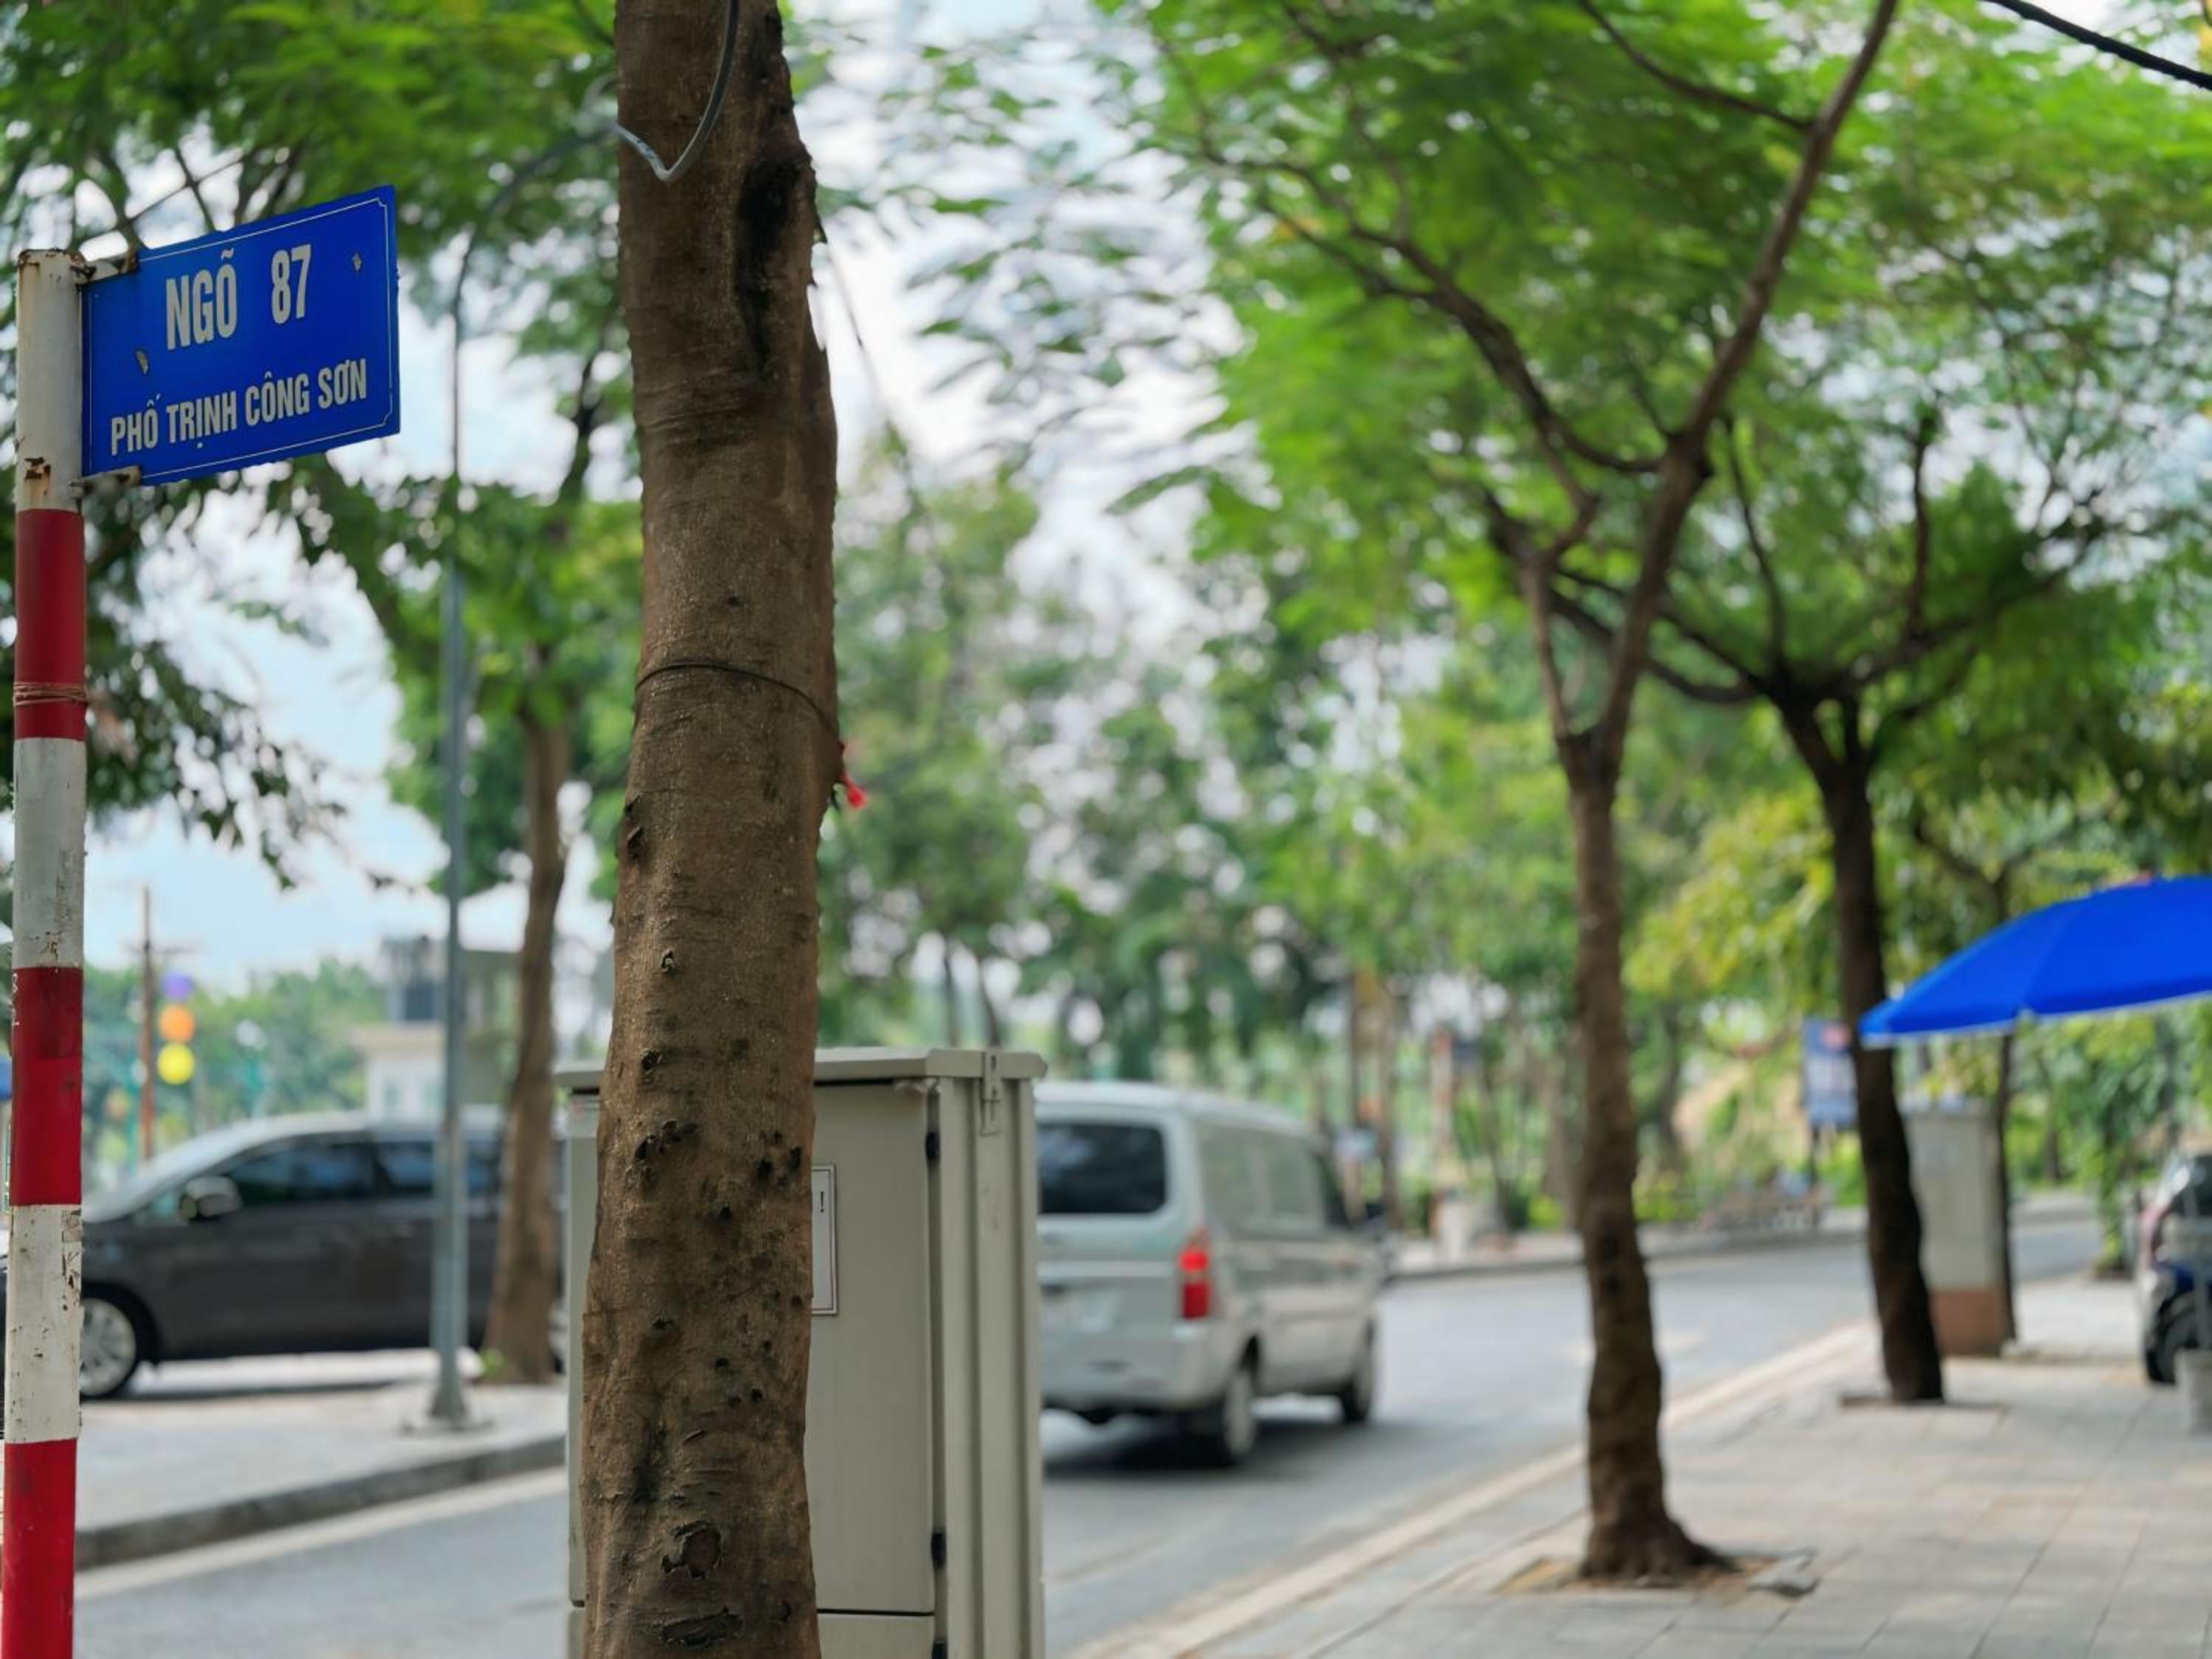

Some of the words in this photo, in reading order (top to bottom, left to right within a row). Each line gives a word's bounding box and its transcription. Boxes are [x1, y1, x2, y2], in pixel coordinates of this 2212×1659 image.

[166, 247, 237, 350] NGÕ
[271, 244, 311, 324] 87
[111, 392, 161, 456] PHỐ
[166, 391, 237, 448] TRỊNH
[245, 371, 310, 425] CÔNG
[318, 358, 366, 408] SƠN
